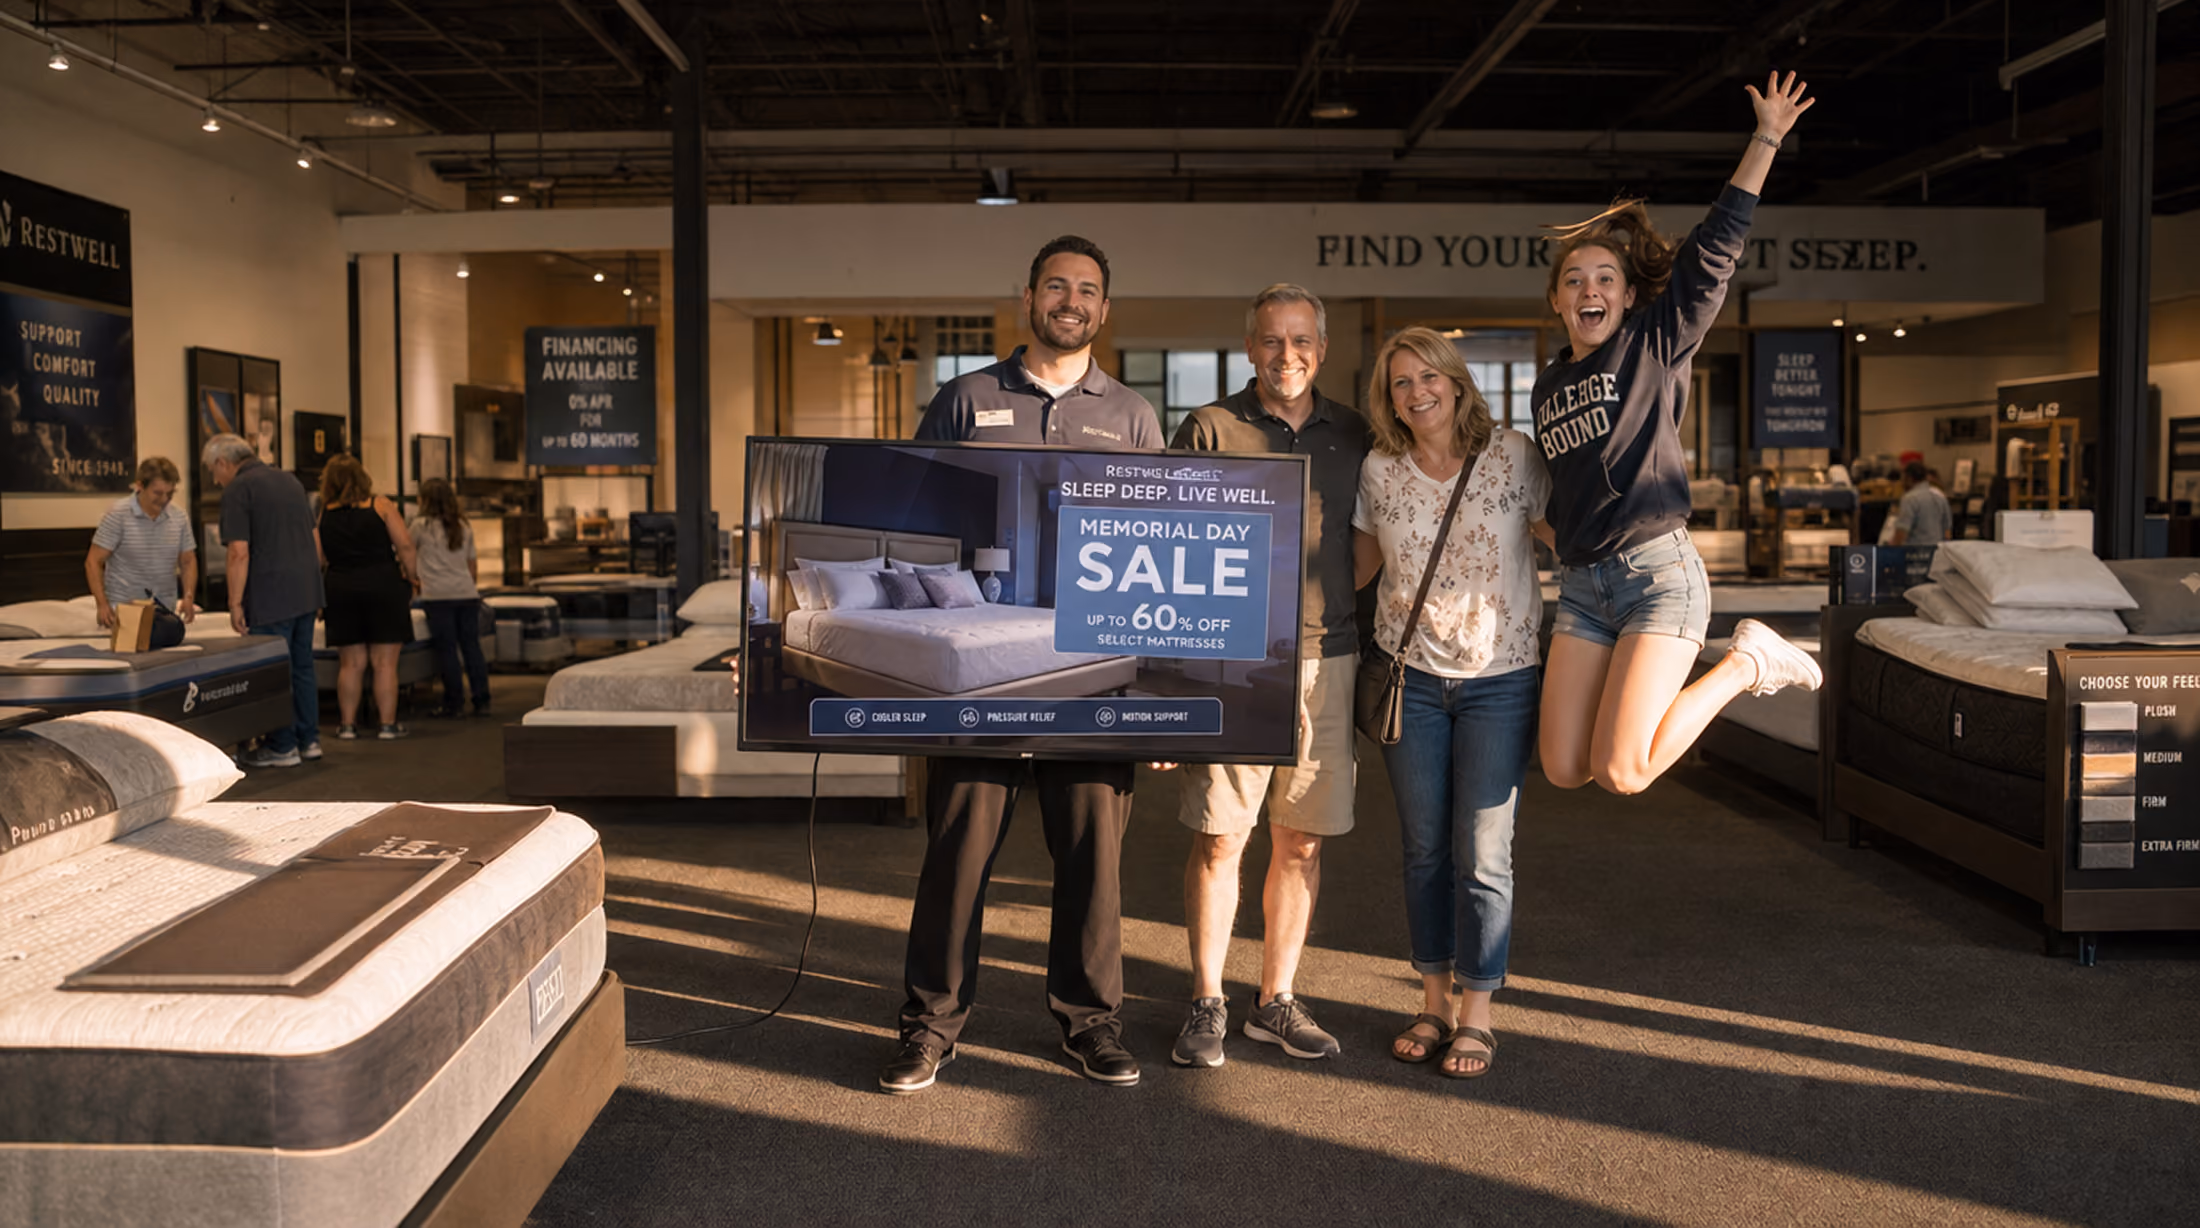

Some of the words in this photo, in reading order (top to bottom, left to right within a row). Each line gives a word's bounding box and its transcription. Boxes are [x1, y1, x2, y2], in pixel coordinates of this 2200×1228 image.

[20, 215, 120, 270] RESTWELL
[1317, 235, 1422, 267] FIND
[1434, 235, 1549, 268] YOUR
[20, 320, 82, 349] SUPPORT
[541, 336, 638, 356] FINANCING
[33, 352, 96, 378] COMFORT
[542, 361, 638, 380] AVAILABLE
[43, 384, 100, 407] QUALITY
[589, 394, 613, 409] APR
[579, 413, 602, 427] FOR
[570, 432, 588, 448] 60
[590, 432, 640, 448] MONTHS
[1540, 406, 1611, 460] BOUND
[51, 458, 92, 476] SINCE
[1061, 481, 1116, 498] SLEEP
[1120, 484, 1171, 501] DEEP.
[1178, 485, 1217, 503] LIVE
[1222, 487, 1275, 505] WELL.
[1080, 518, 1199, 540] MEMORIAL
[1206, 523, 1251, 542] DAY
[1076, 541, 1249, 597] SALE
[1087, 614, 1104, 626] UP
[1107, 615, 1126, 627] TO
[1131, 602, 1193, 632] 60%
[1197, 617, 1231, 632] OFF
[1097, 633, 1144, 646] SELECT
[2079, 676, 2129, 690] CHOOSE
[2134, 675, 2168, 690] YOUR
[2143, 752, 2182, 764] MEDIUM
[2141, 840, 2173, 852] EXTRA
